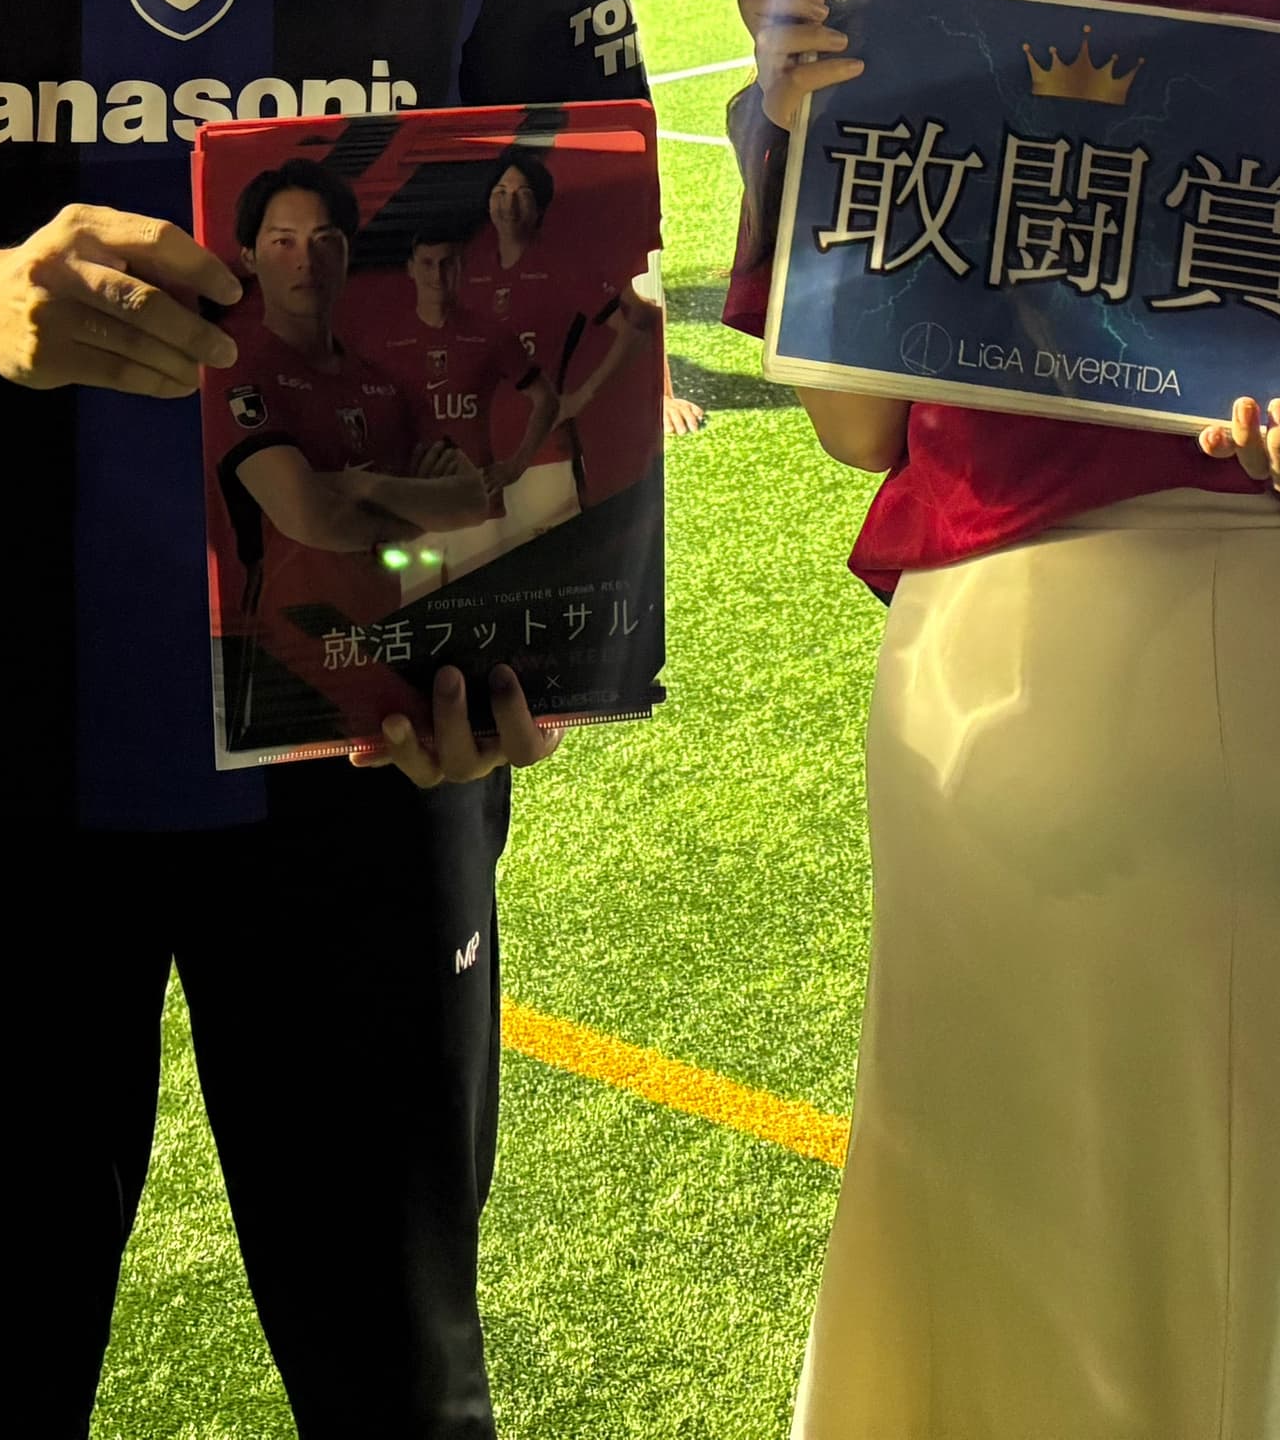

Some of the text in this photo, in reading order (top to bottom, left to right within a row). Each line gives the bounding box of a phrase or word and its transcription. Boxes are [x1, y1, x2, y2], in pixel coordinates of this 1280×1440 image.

[322, 598, 639, 671] 就活フットサル
